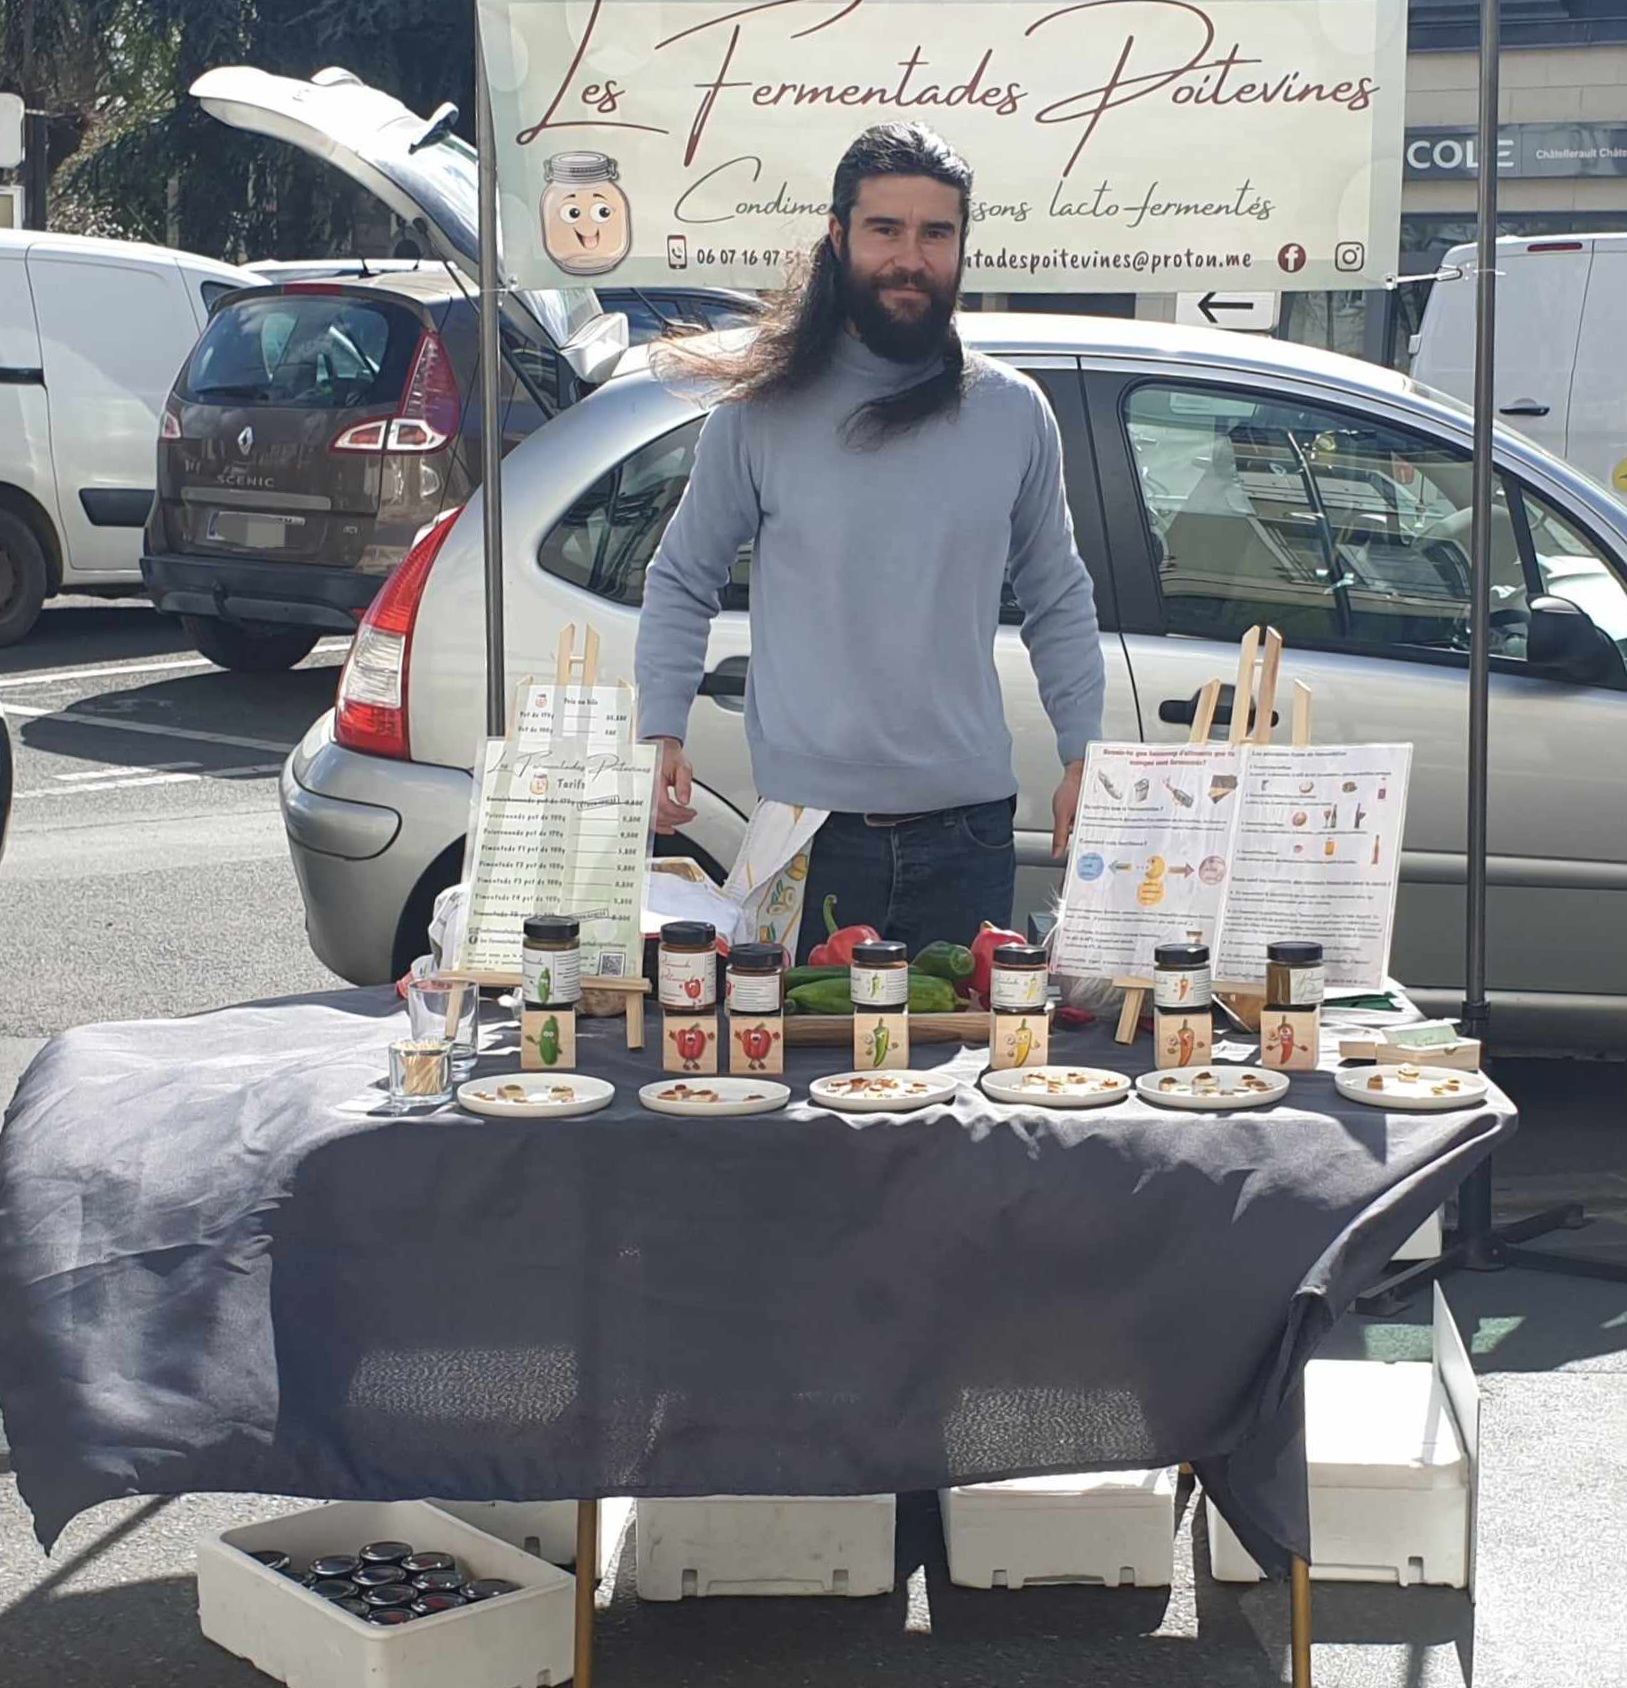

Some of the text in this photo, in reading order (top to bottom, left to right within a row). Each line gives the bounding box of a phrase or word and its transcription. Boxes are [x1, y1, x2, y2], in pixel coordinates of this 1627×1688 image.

[515, 0, 1380, 178] Les Fermentades Poitevines
[674, 156, 833, 224] Condime
[1049, 179, 1276, 228] lacto-fermentés
[697, 249, 716, 265] 06
[720, 249, 736, 265] 07
[742, 250, 758, 266] 16
[763, 250, 781, 267] 97
[965, 247, 1253, 275] ntadespoitevines@proton.me
[217, 474, 276, 488] SCENIC
[557, 778, 586, 791] Tarifs
